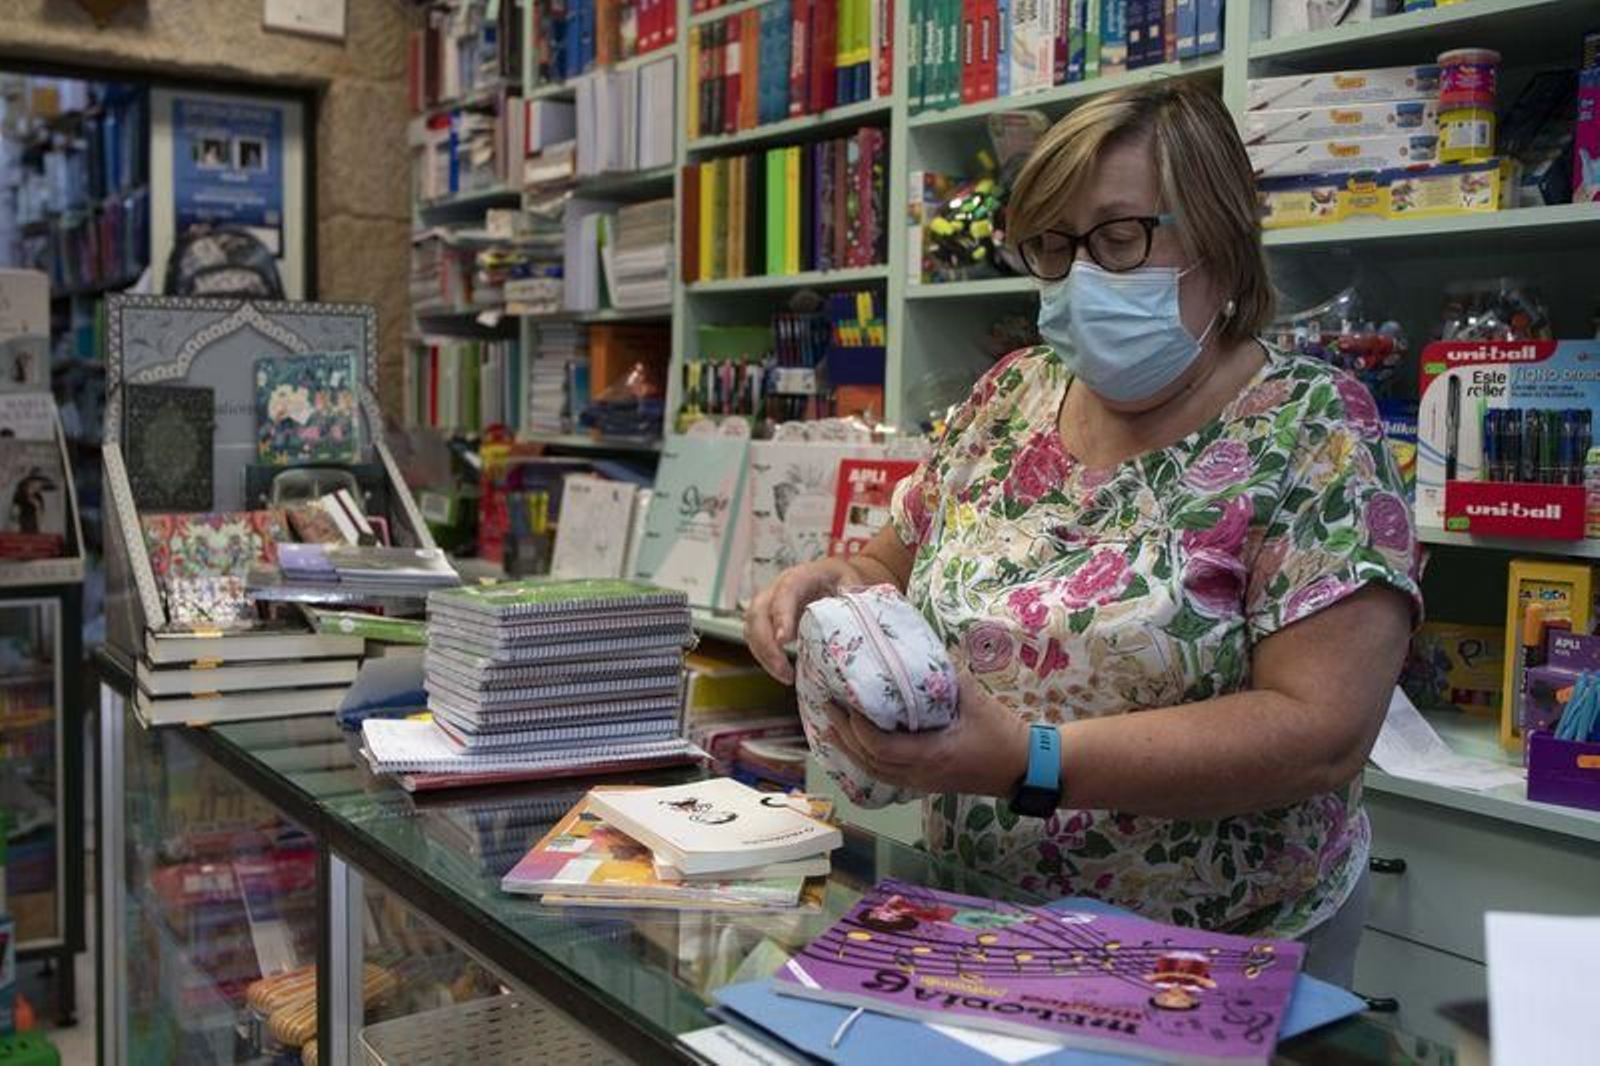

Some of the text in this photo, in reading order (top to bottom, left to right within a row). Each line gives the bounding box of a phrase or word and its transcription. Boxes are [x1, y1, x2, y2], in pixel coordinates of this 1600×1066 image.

[1472, 370, 1507, 385] Este
[1466, 384, 1506, 398] roller
[847, 468, 887, 483] APLI
